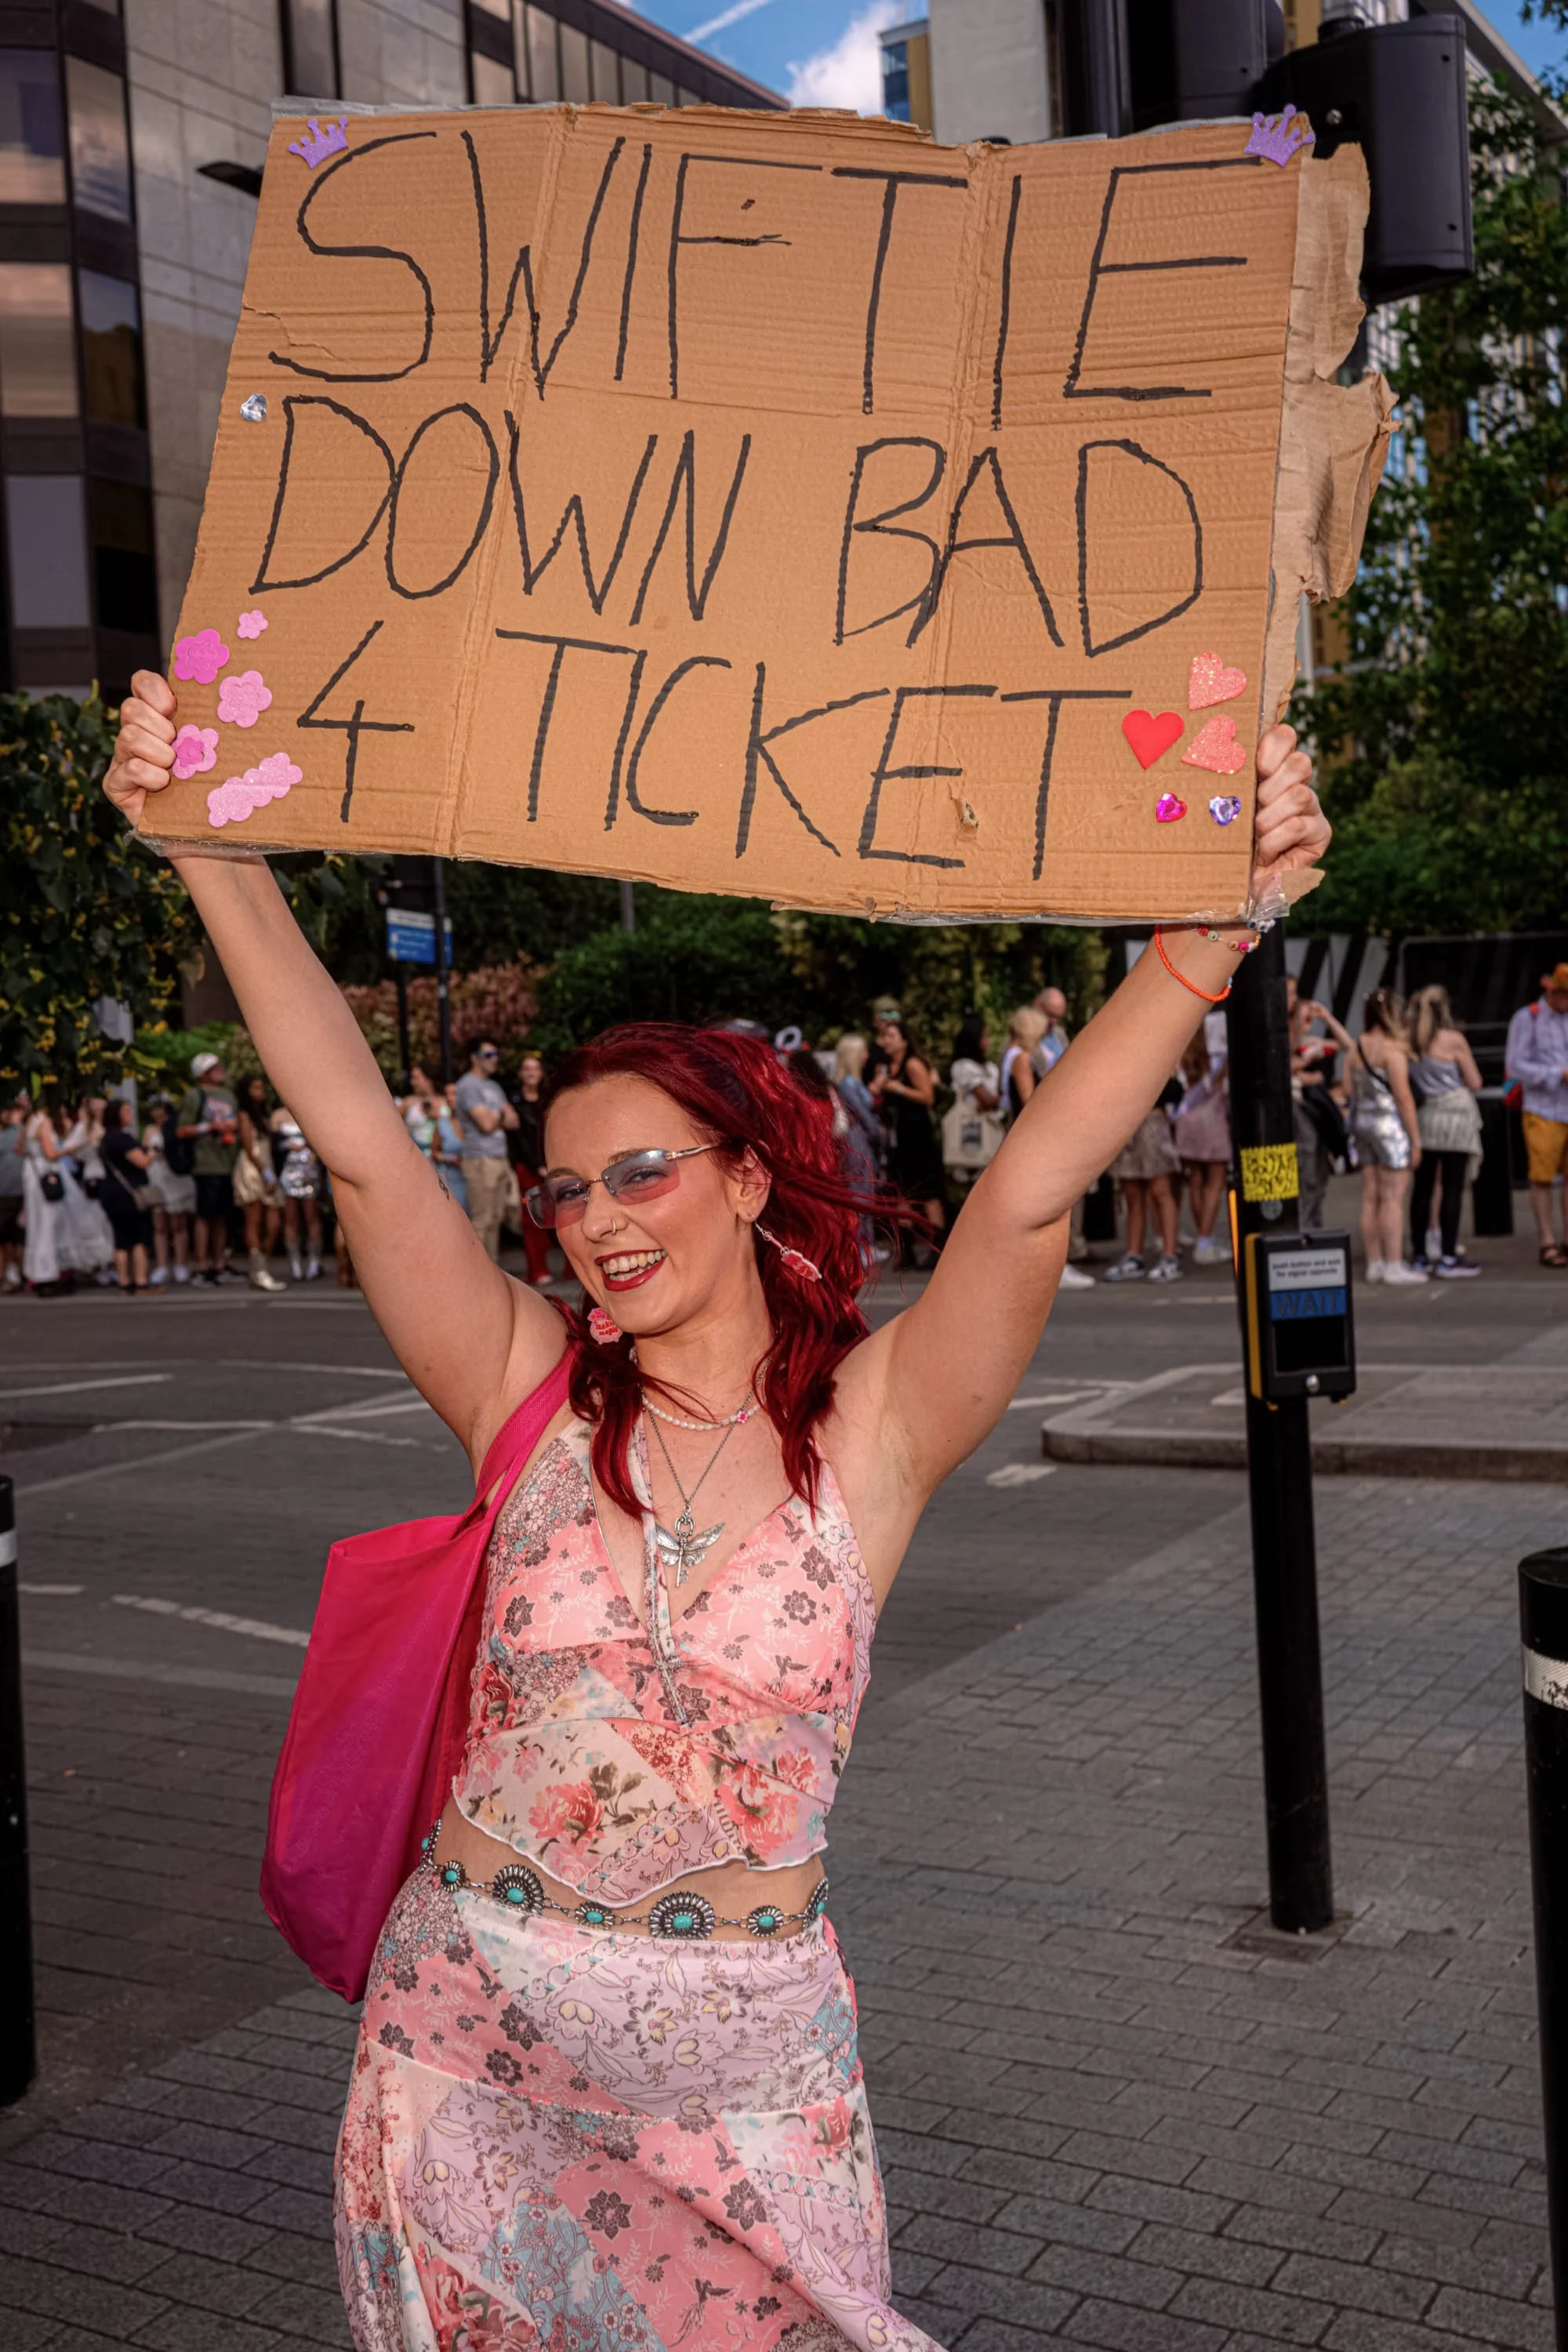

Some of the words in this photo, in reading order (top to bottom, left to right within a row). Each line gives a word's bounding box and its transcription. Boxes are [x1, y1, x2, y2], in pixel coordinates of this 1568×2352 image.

[267, 129, 1263, 431] SWIFTIE
[248, 394, 751, 626] DOWN
[833, 436, 1204, 659] BAD
[296, 620, 416, 823] 4
[495, 628, 1133, 880] TICKET
[1275, 1290, 1343, 1318] WAIT
